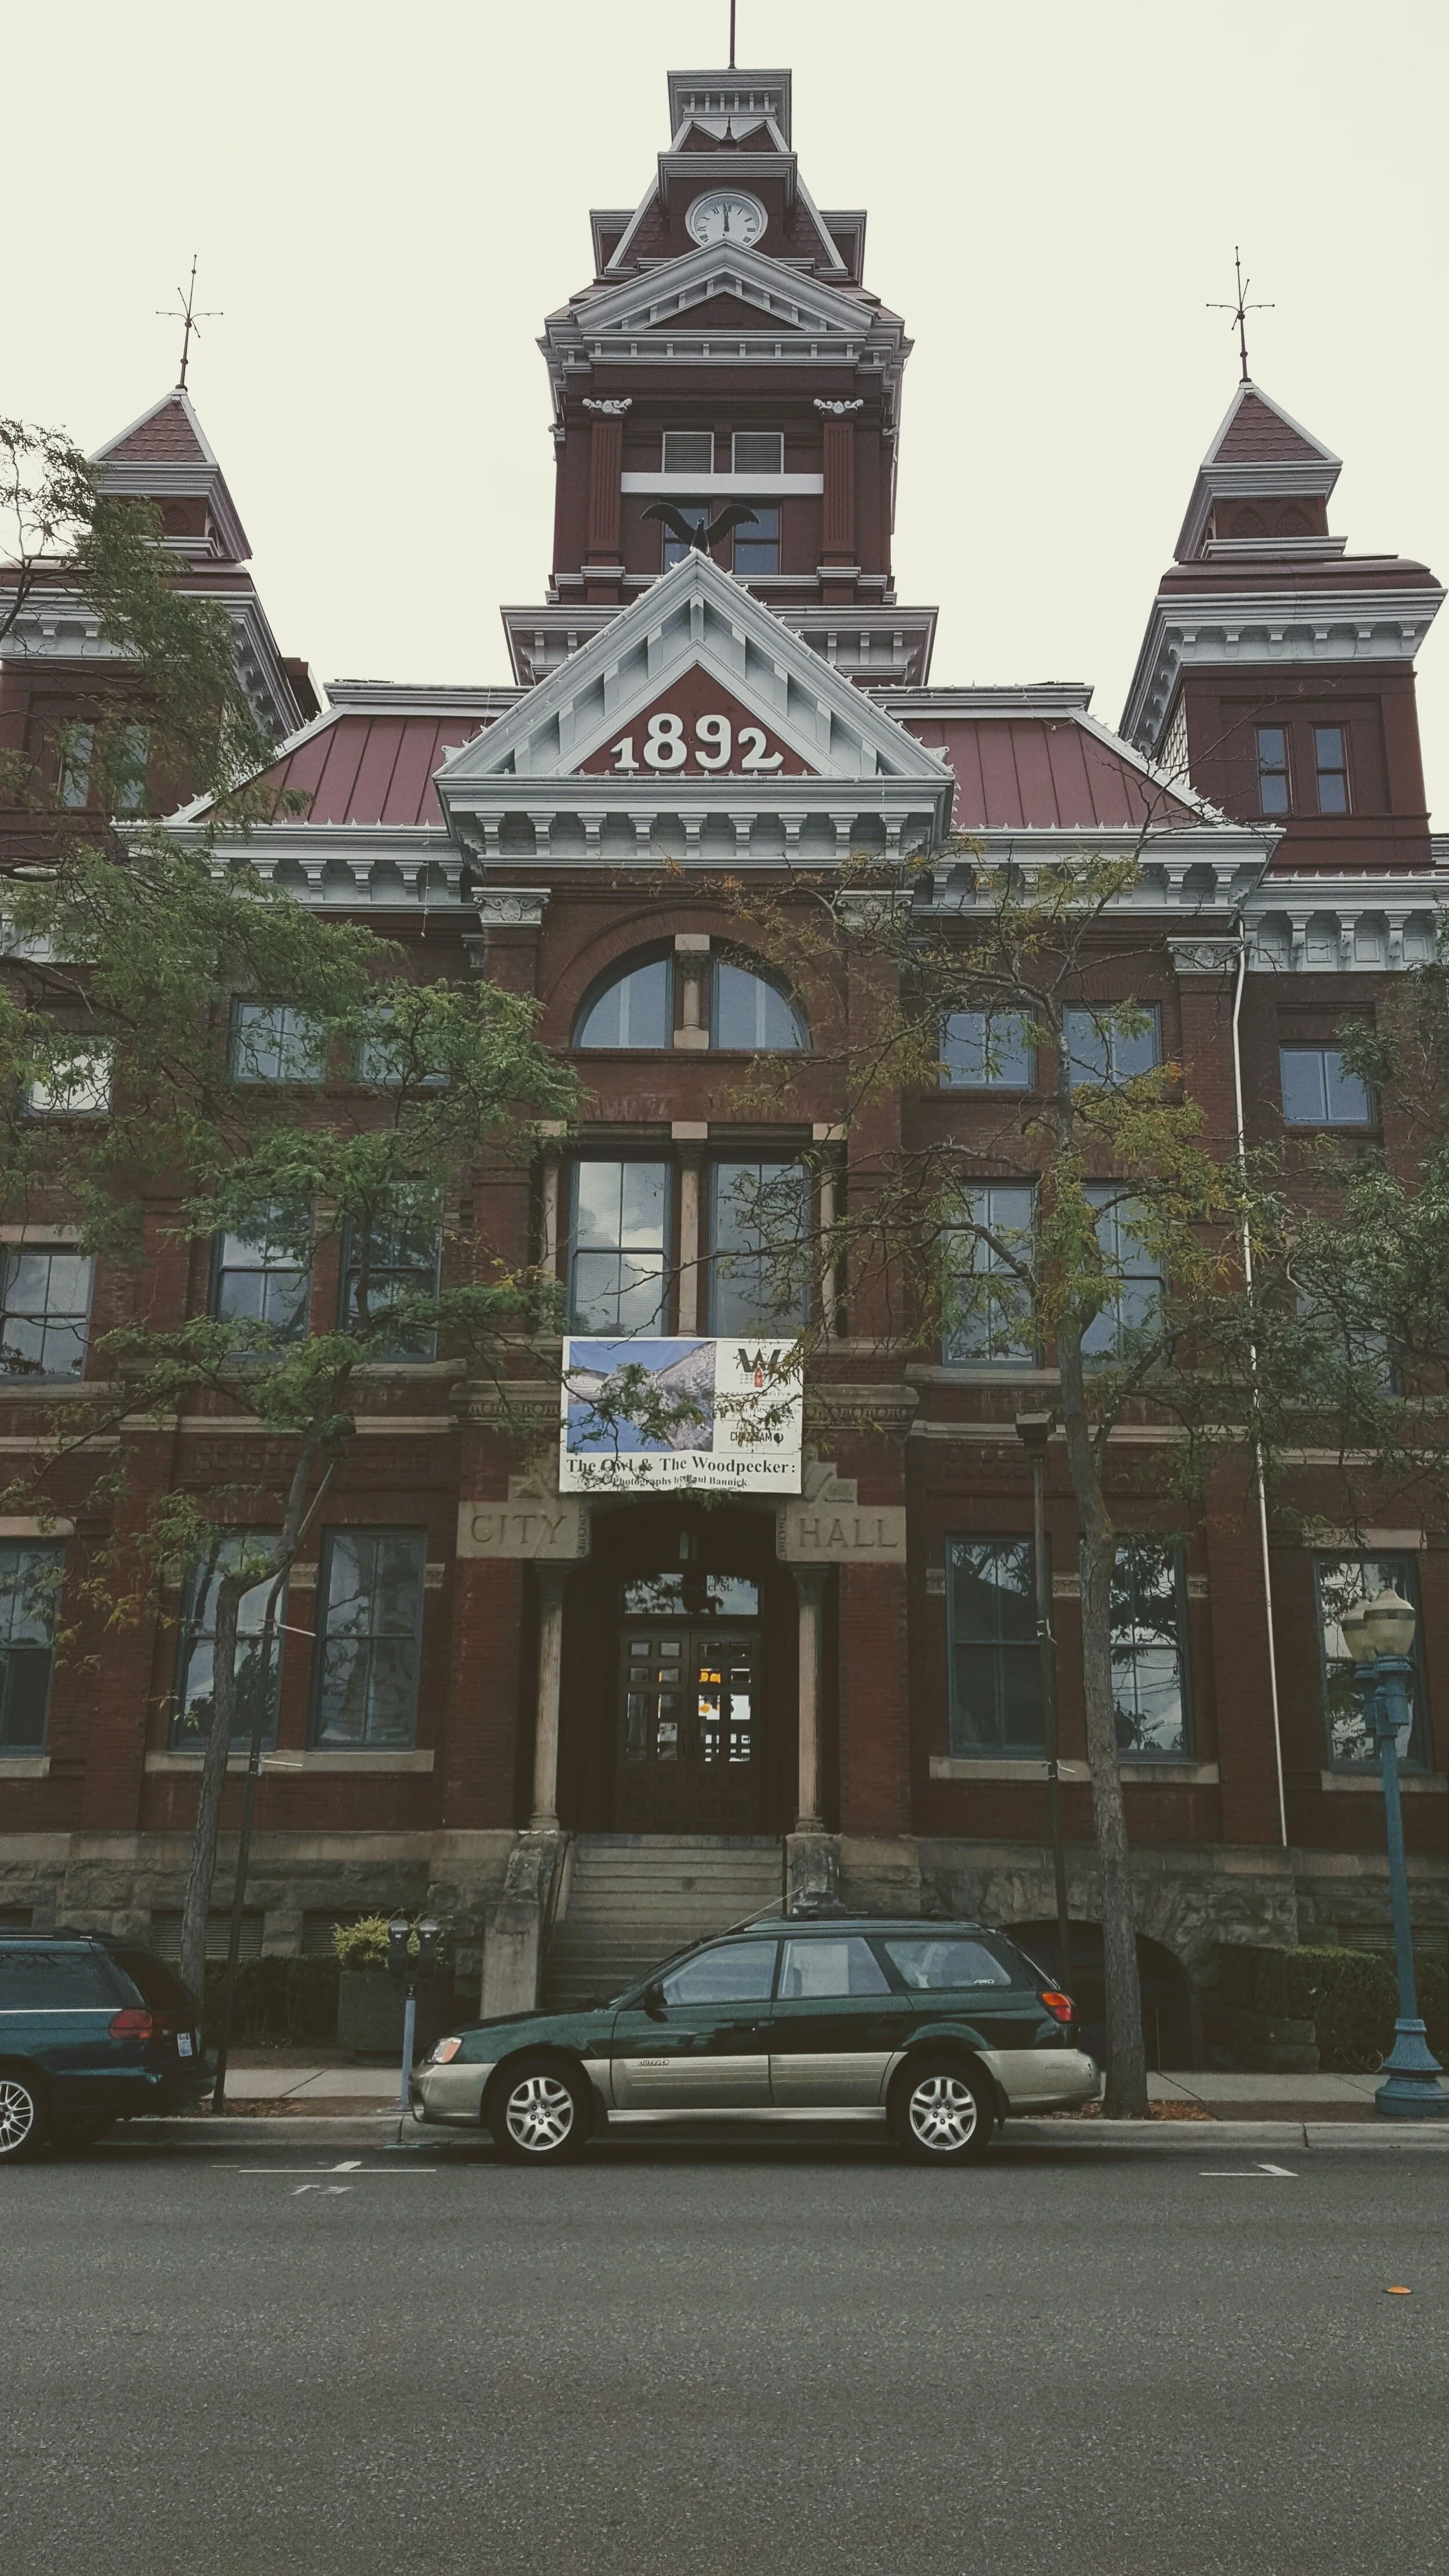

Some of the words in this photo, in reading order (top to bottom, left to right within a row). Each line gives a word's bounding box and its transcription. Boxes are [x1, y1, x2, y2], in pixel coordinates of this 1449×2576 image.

[610, 713, 784, 770] 1892
[566, 1459, 596, 1473] The
[600, 1459, 633, 1472] Owl
[639, 1458, 653, 1471] &
[660, 1458, 686, 1471] The
[692, 1456, 795, 1475] Woodpecker:
[613, 1476, 671, 1488] Photographs
[472, 1515, 567, 1544] CITY
[799, 1518, 898, 1547] HALL
[408, 1987, 413, 1995] 2
